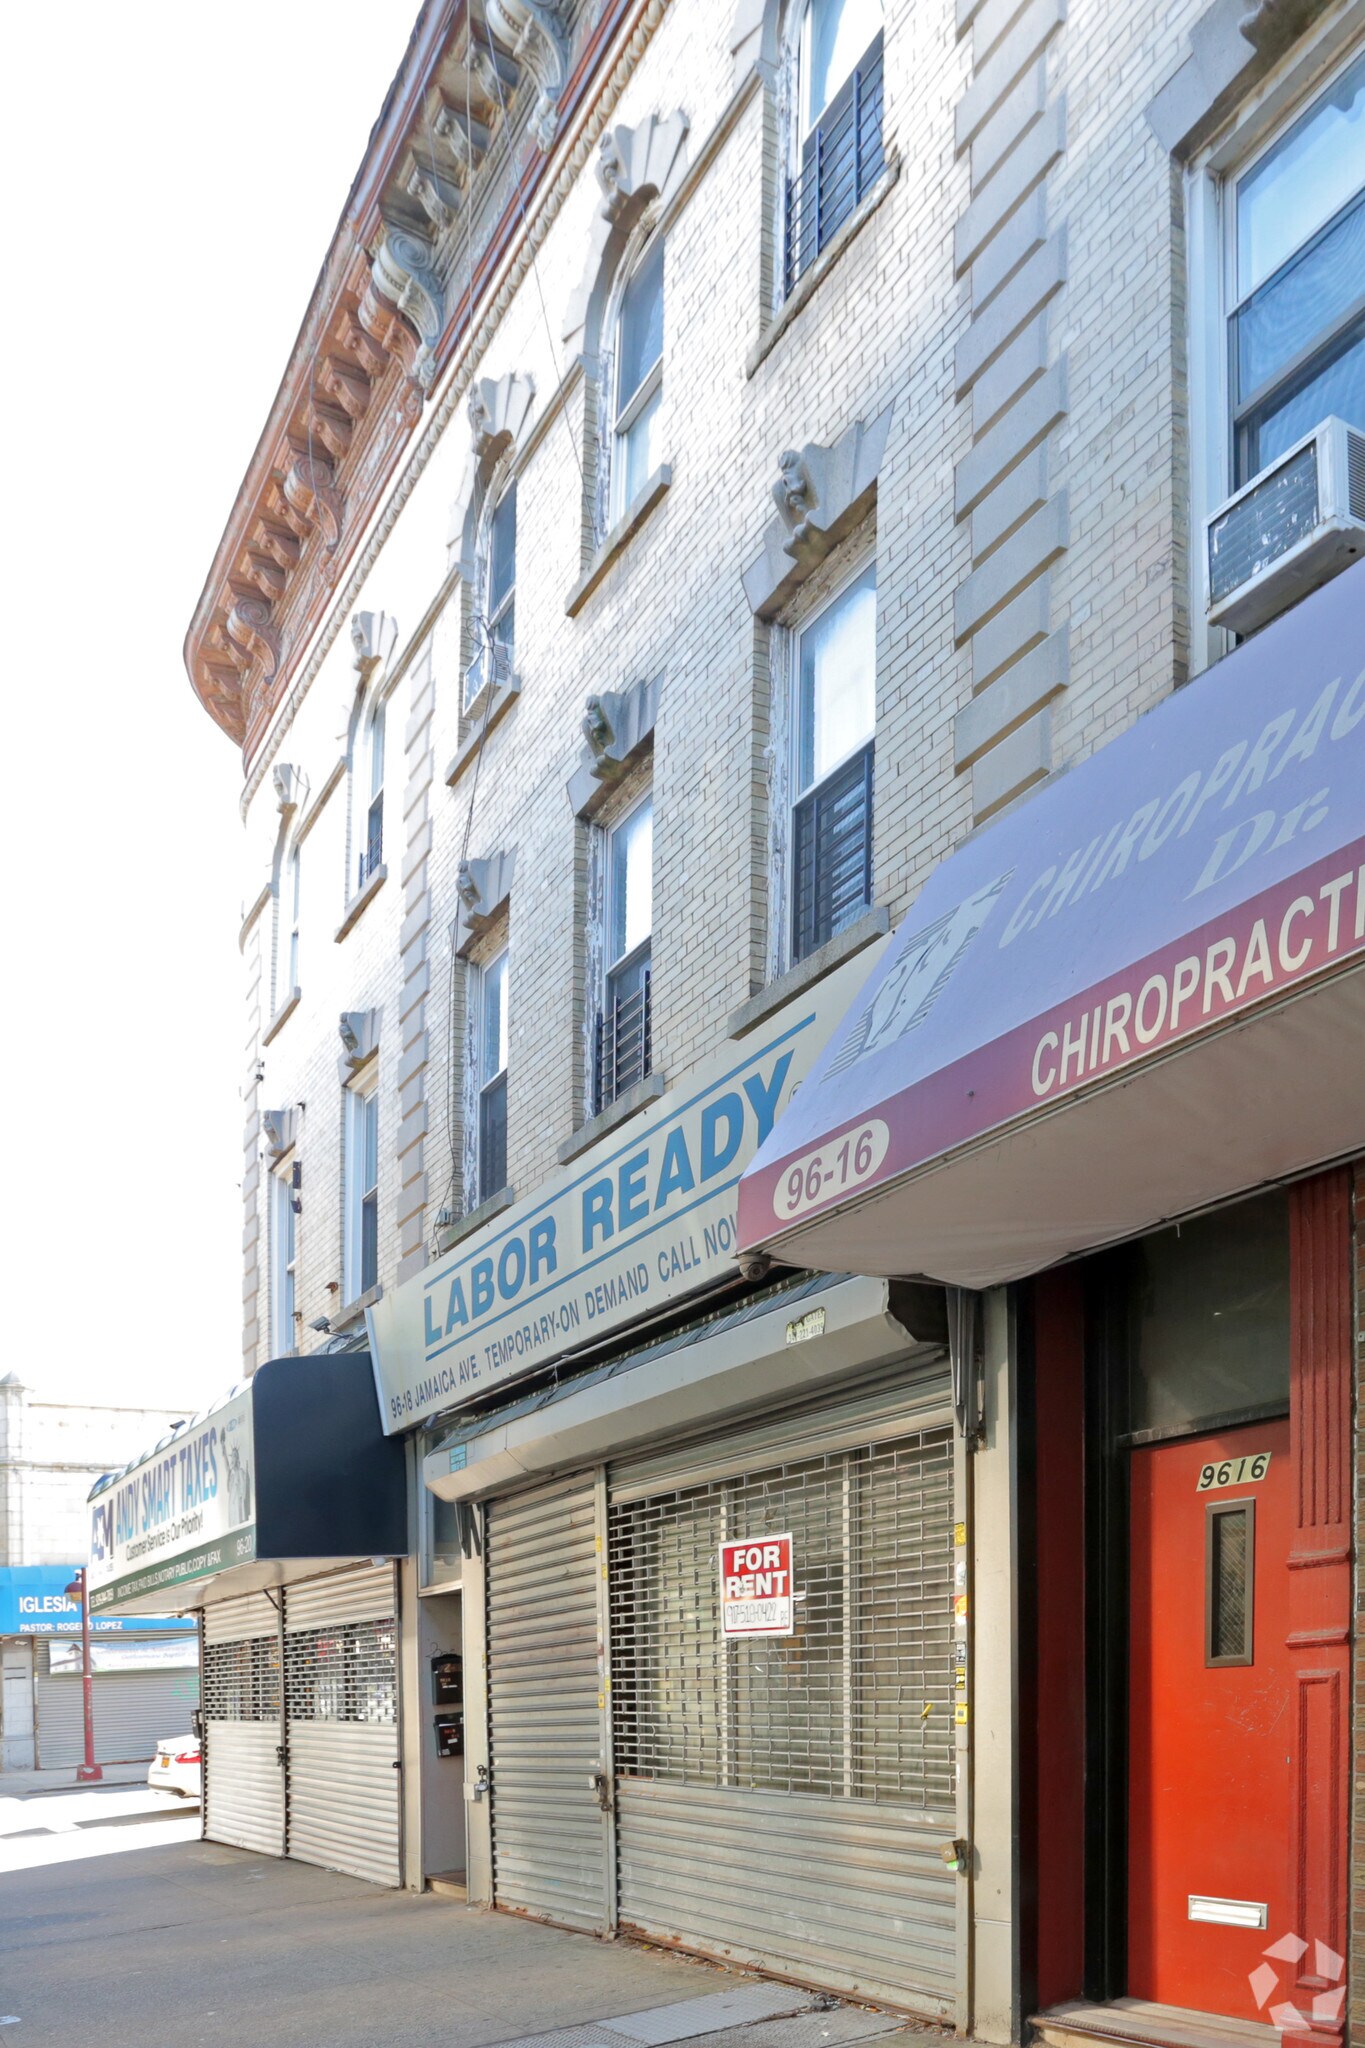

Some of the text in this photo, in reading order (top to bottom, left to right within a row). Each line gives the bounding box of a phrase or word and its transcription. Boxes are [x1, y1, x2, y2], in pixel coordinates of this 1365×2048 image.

[1182, 787, 1330, 902] Dr.
[787, 1129, 873, 1211] 96-16
[424, 1048, 796, 1348] LABOR READY
[391, 1389, 413, 1418] 96-18
[414, 1367, 457, 1407] JAMAICA
[459, 1354, 481, 1385] AVE.
[484, 1299, 581, 1371] TEMPORARY-ON
[584, 1262, 650, 1320] DEMAND
[658, 1236, 702, 1282] CALL
[116, 1477, 140, 1546] ANDY
[142, 1453, 177, 1533] SMART
[179, 1426, 218, 1513] TAXES
[1200, 1455, 1267, 1489] 9616
[126, 1541, 147, 1561] Customer
[147, 1530, 165, 1552] Service
[171, 1523, 181, 1541] Our
[237, 1534, 252, 1557] 96-20
[733, 1545, 780, 1573] FOR
[726, 1570, 788, 1598] RENT
[19, 1596, 78, 1613] IGLESIA
[20, 1623, 55, 1633] PASTOR:
[96, 1621, 123, 1630] LOPEZ
